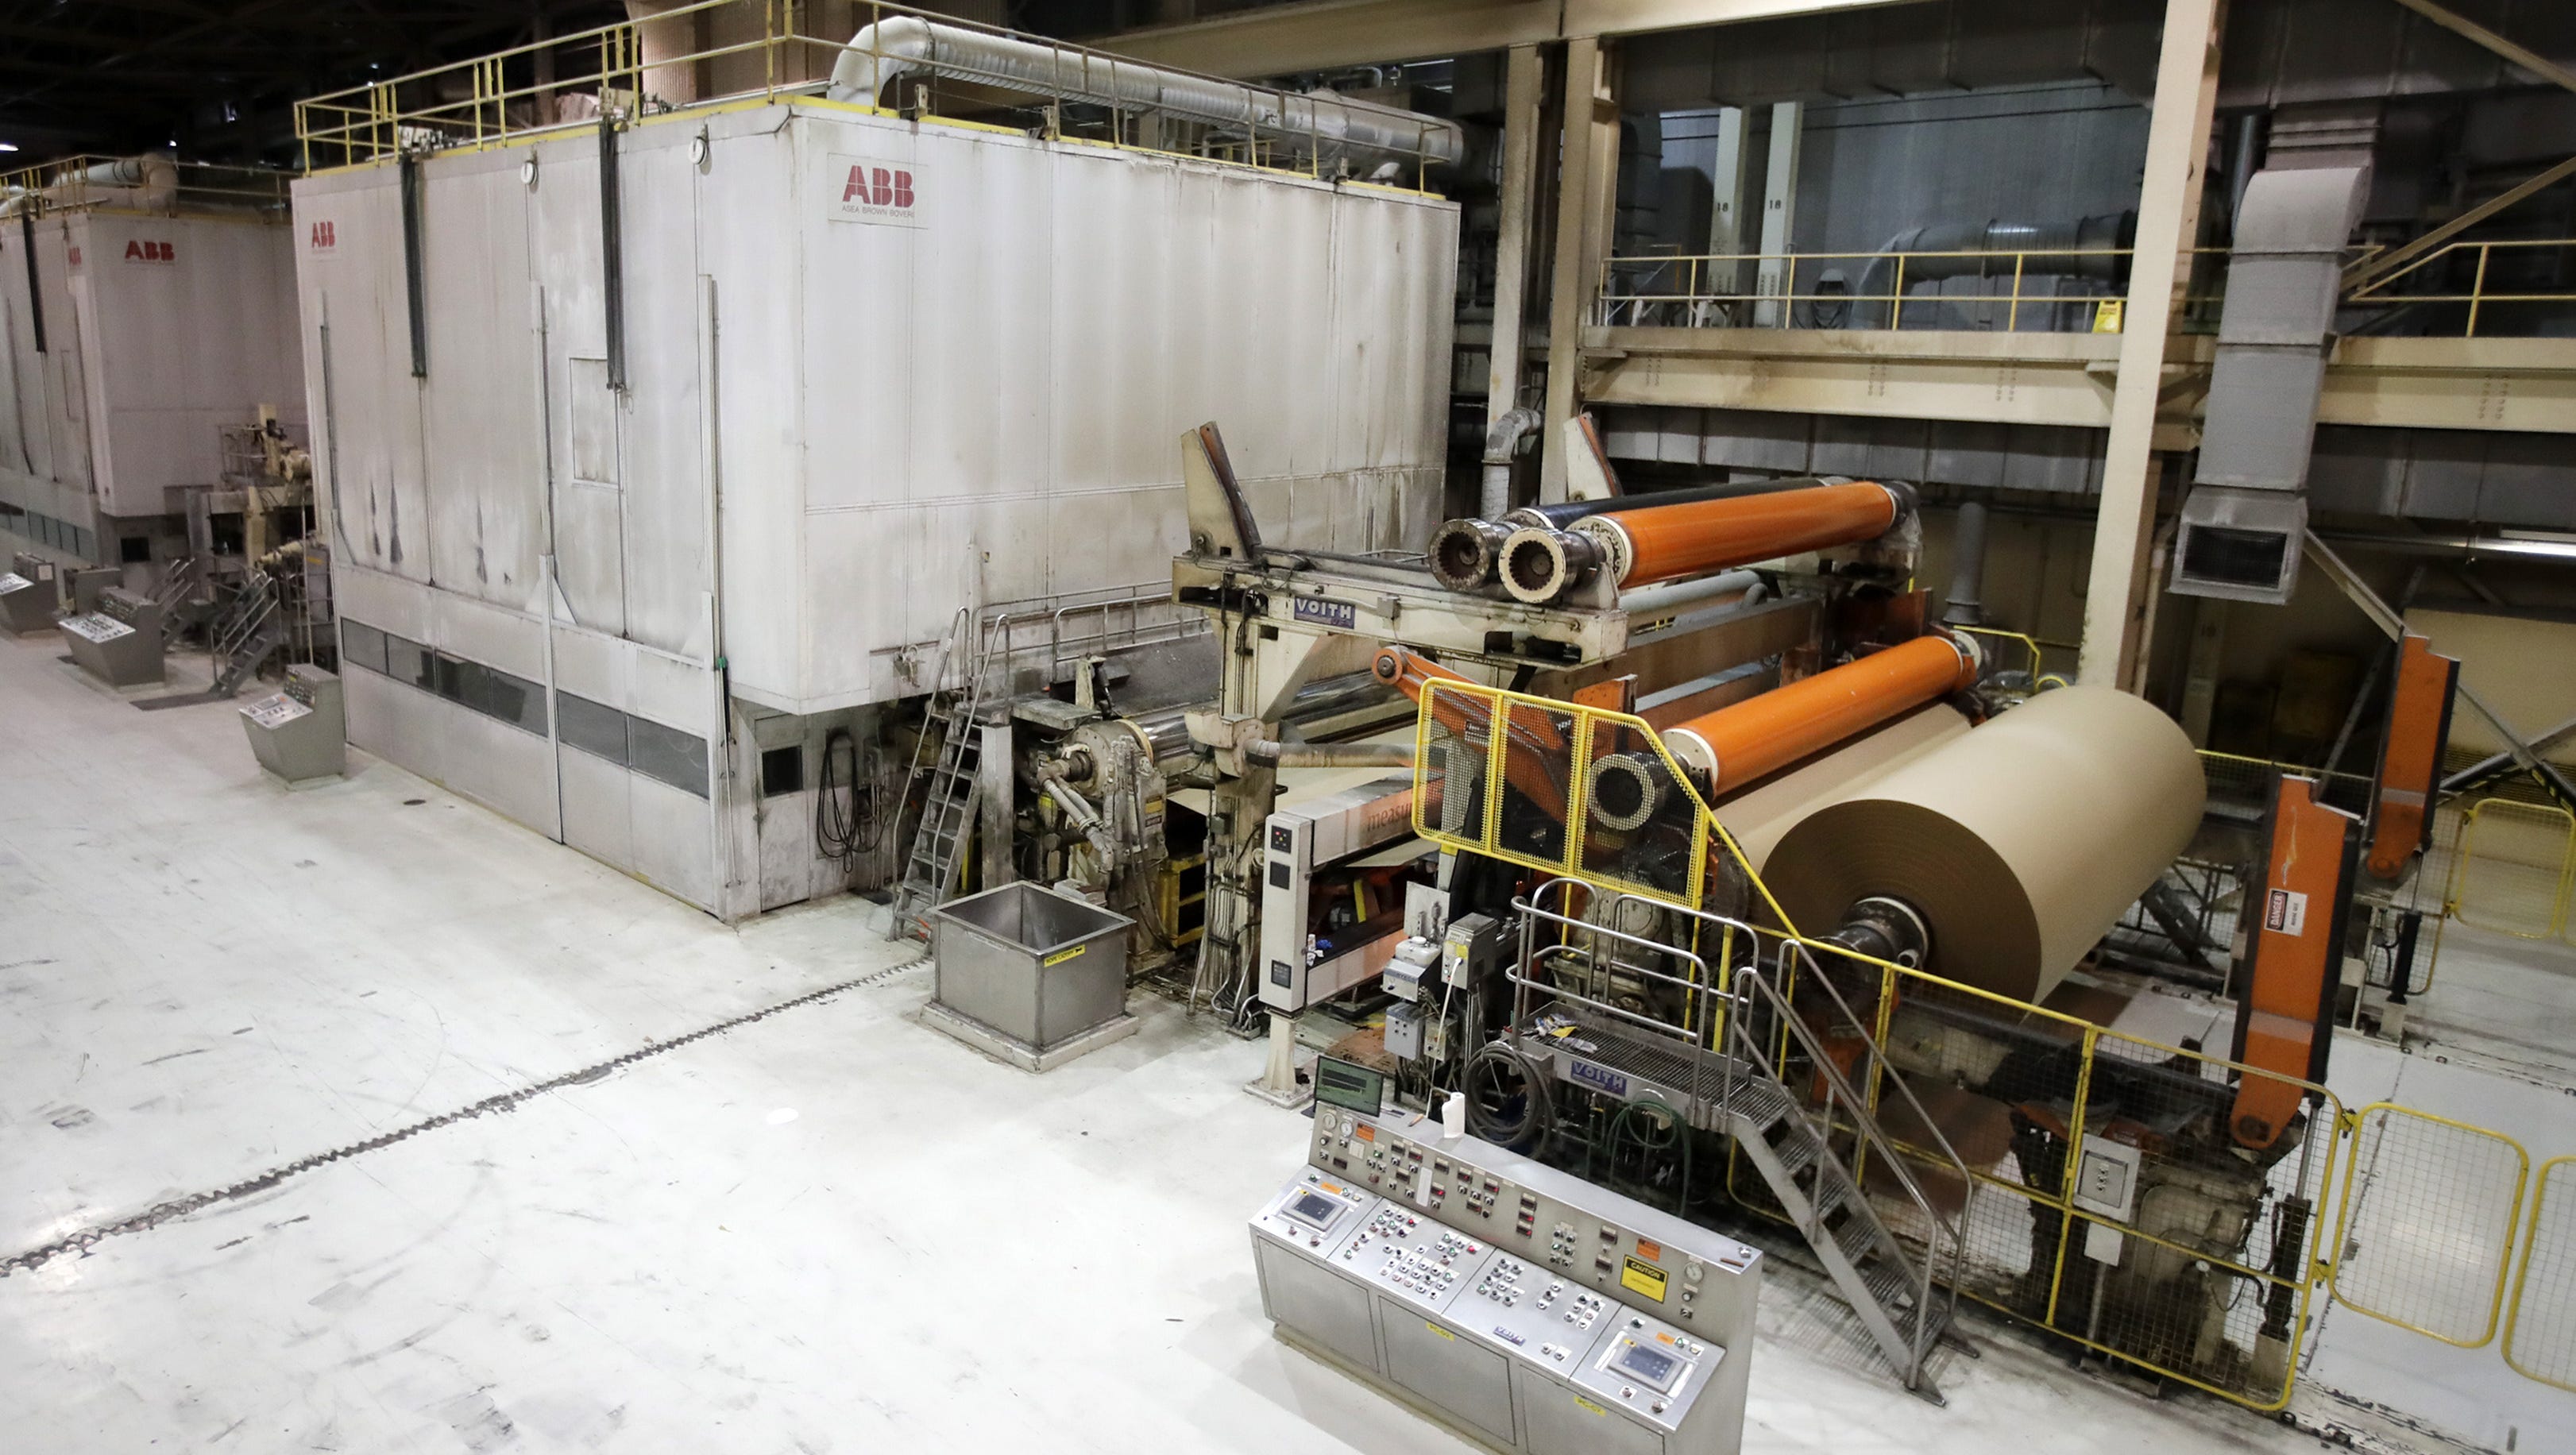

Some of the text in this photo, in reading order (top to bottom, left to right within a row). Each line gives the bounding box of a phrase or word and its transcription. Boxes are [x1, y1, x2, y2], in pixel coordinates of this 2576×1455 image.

[842, 164, 915, 208] ABB
[842, 205, 859, 214] ASEA
[862, 206, 888, 216] BROWN
[1717, 202, 1729, 212] 18
[1770, 199, 1782, 210] 18
[311, 220, 336, 248] ABB
[125, 240, 176, 261] ABB
[1296, 598, 1352, 619] VOITH
[2269, 894, 2283, 926] DANGER
[1574, 1061, 1624, 1089] VOITH
[1630, 1261, 1661, 1279] CAUTION
